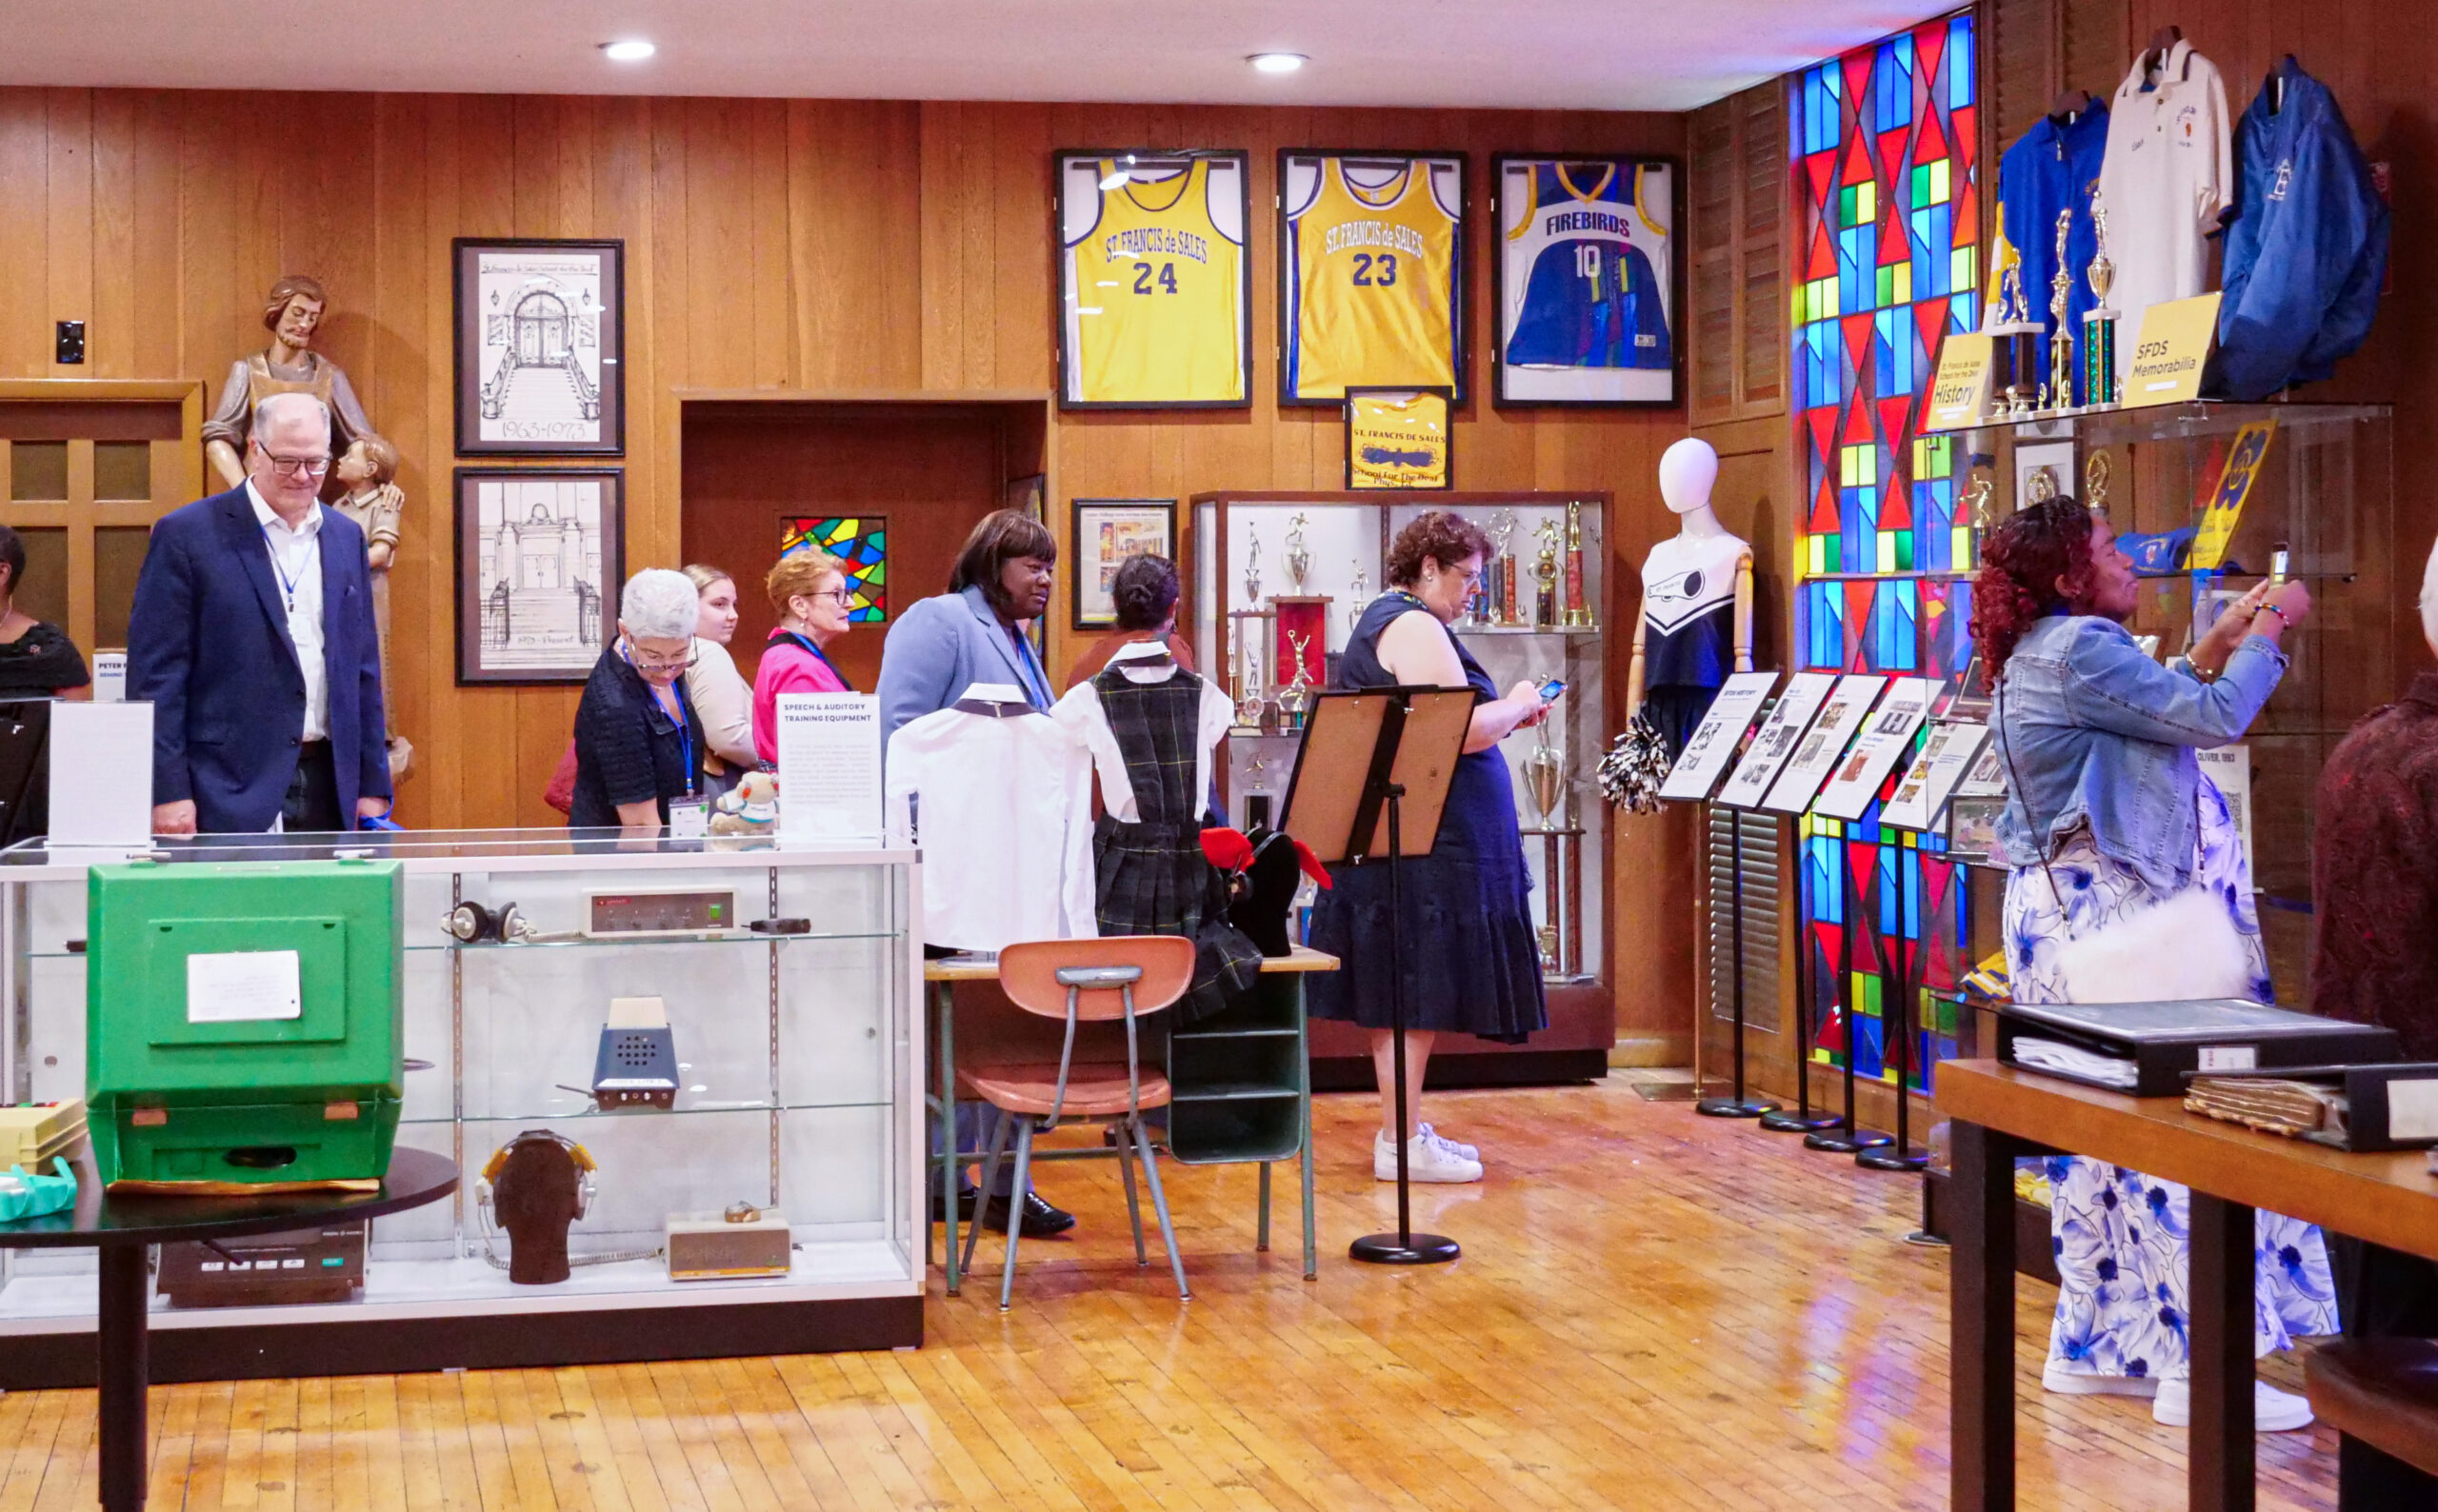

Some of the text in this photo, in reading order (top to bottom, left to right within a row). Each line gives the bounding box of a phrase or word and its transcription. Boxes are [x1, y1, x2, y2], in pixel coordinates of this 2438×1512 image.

[1547, 211, 1630, 238] FIREBIRDS
[1121, 228, 1162, 253] FRANCIS
[1165, 229, 1176, 253] de
[1178, 230, 1207, 265] SALES
[1341, 220, 1381, 248] FRANCIS
[1382, 222, 1393, 248] de
[1395, 224, 1423, 259] SALES
[1352, 253, 1396, 287] 23
[1573, 245, 1601, 278] 10
[1133, 262, 1178, 295] 24
[2137, 340, 2168, 360] SFDS
[2132, 356, 2196, 378] Memorabilia
[1934, 383, 1976, 407] History
[501, 421, 587, 440] 1963-1973
[1368, 429, 1404, 441] FRANCIS
[1419, 435, 1446, 444] SALES
[825, 714, 871, 723] EQUIPMENT
